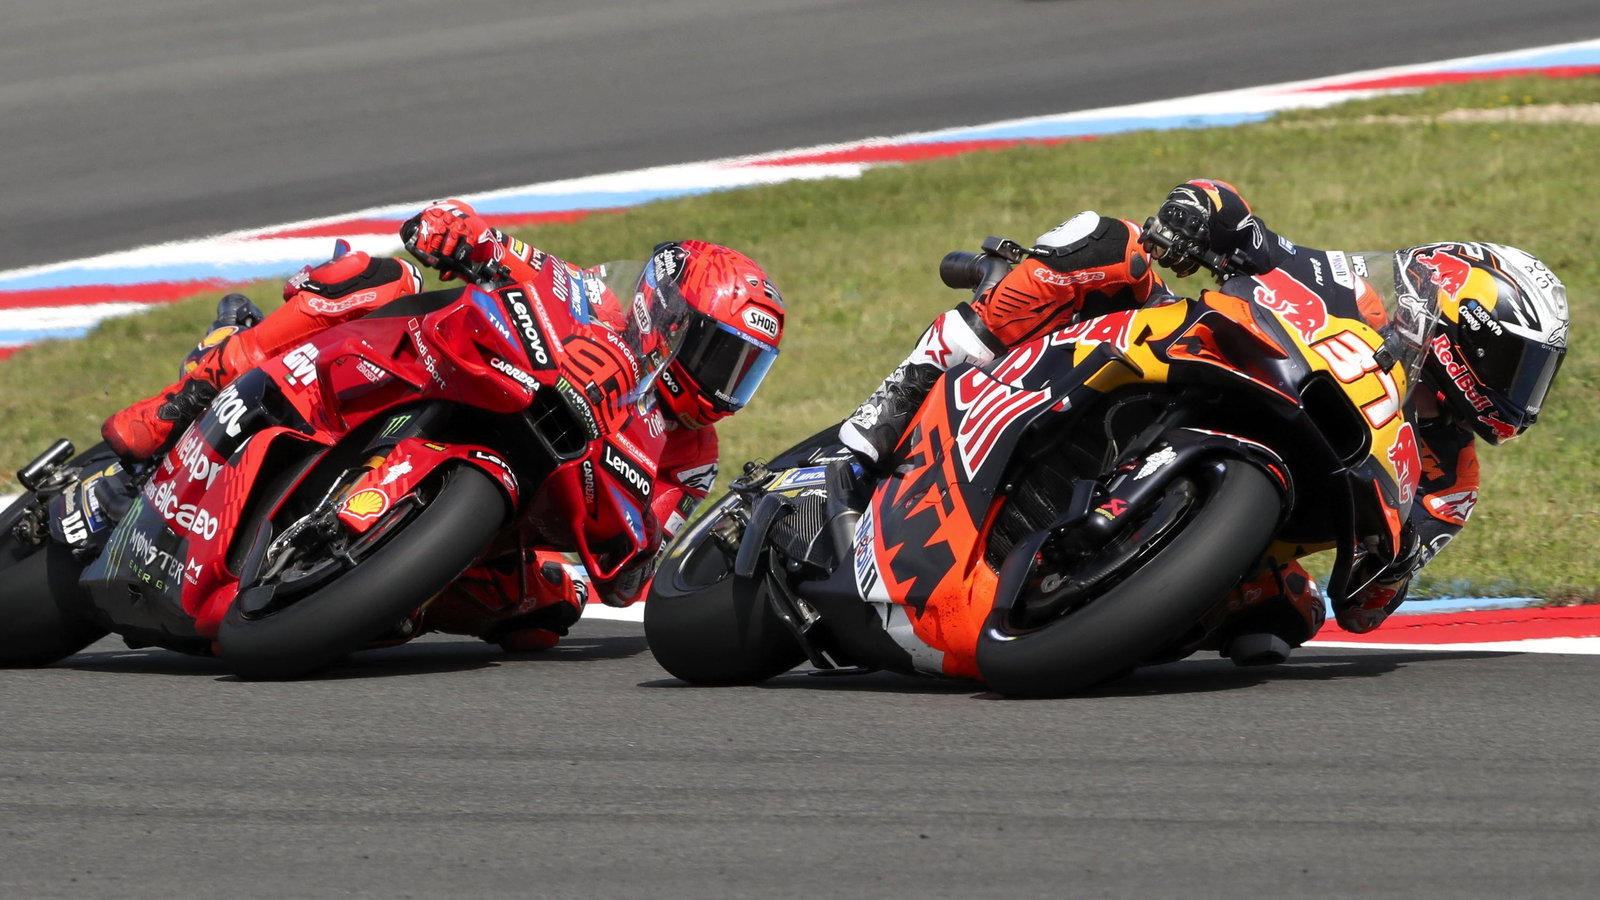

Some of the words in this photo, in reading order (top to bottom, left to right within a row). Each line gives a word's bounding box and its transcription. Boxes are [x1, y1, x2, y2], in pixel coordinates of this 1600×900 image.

[488, 312, 510, 340] TIM
[507, 291, 548, 365] Lenovo
[634, 297, 649, 329] SHOEI
[749, 312, 777, 335] SHOEI
[413, 330, 428, 357] Audi
[424, 355, 446, 390] Sport
[490, 358, 540, 392] CARRERA
[651, 351, 679, 393] Leovo
[1309, 329, 1401, 430] 37
[1431, 333, 1466, 379] Red
[1455, 373, 1494, 412] Bull
[568, 388, 600, 439] MONSTER
[605, 446, 650, 496] Lenovo
[616, 433, 657, 471] FRECCIAROSSA
[1420, 438, 1445, 481] TM
[583, 460, 595, 504] CARRERA
[128, 559, 170, 593] ENERGY
[130, 528, 184, 585] MONSTER
